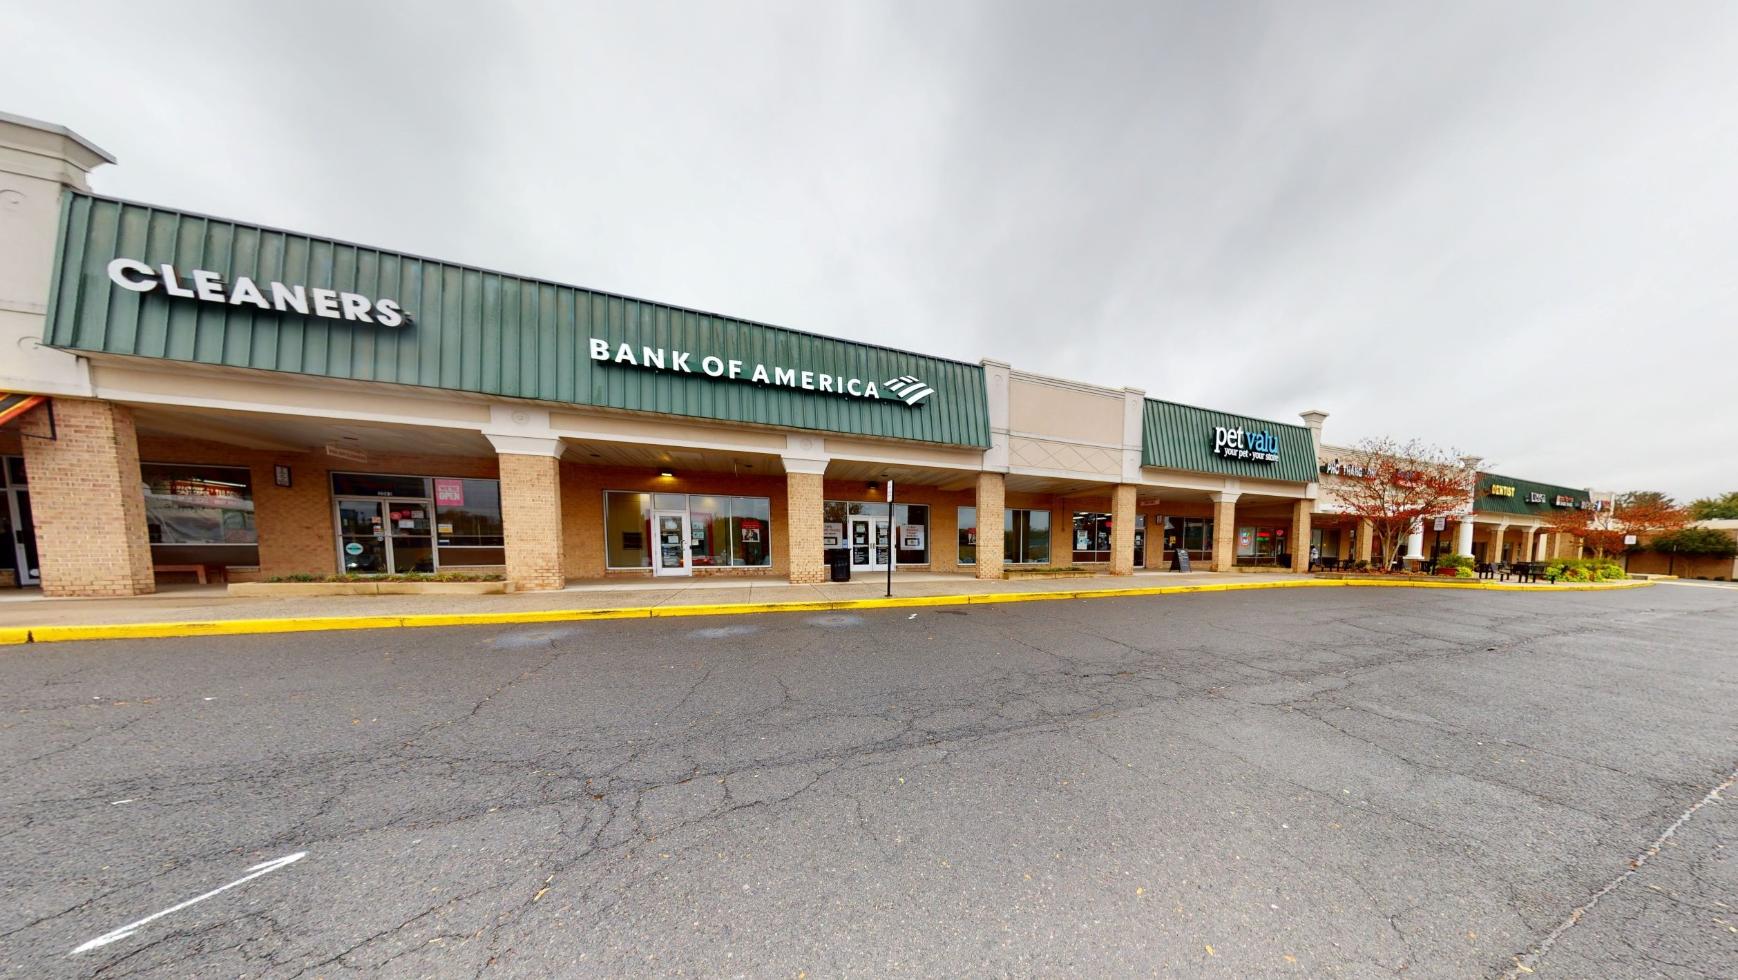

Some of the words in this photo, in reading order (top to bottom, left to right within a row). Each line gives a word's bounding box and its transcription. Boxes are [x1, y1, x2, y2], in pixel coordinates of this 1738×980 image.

[107, 258, 403, 327] CLEANERS
[589, 338, 692, 374] BANK
[702, 356, 742, 379] OF
[752, 363, 880, 399] AMERICA
[1214, 426, 1244, 453] pet
[1246, 430, 1279, 453] valu
[1224, 447, 1239, 457] your
[1238, 449, 1248, 459] pet
[1252, 451, 1265, 461] your
[1492, 484, 1515, 498] DENTIST
